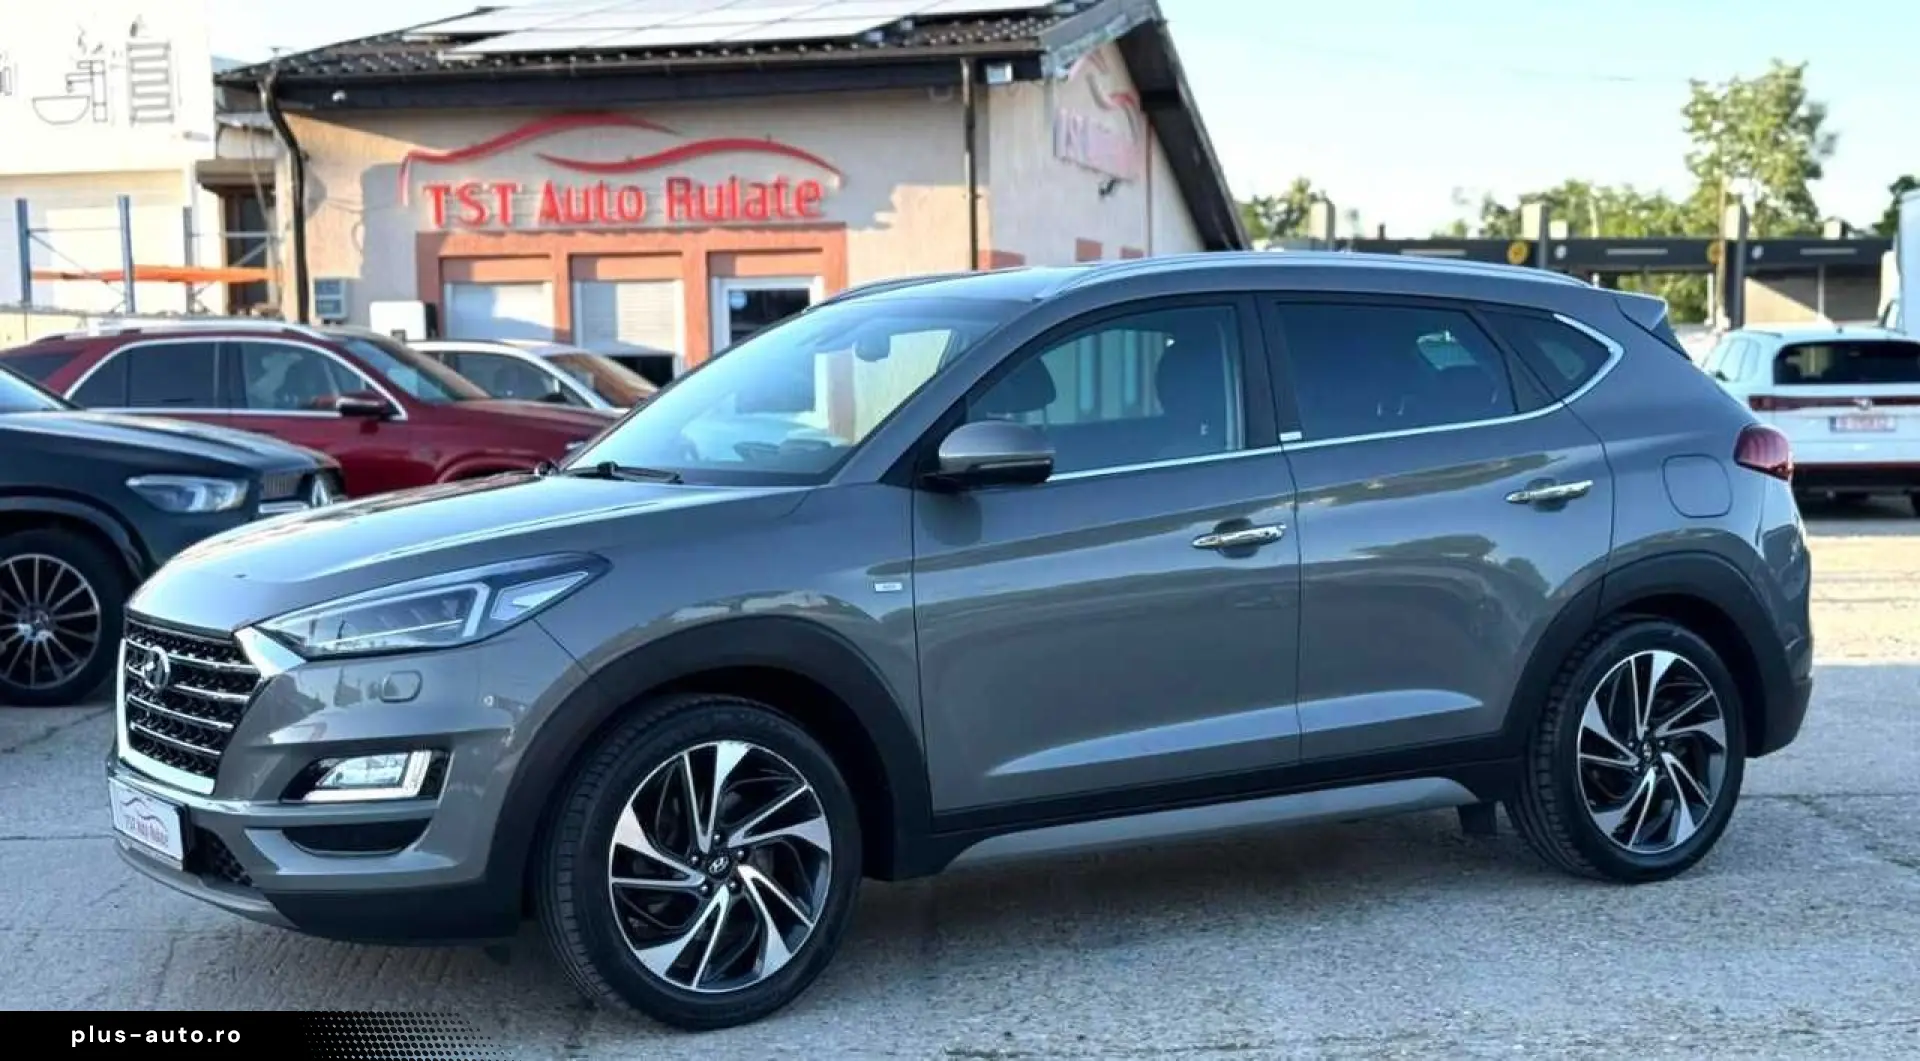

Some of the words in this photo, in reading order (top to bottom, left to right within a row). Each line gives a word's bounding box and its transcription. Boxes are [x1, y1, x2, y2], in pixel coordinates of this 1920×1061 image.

[423, 181, 521, 228] TST
[538, 178, 646, 225] Auto
[665, 173, 824, 222] Rulate
